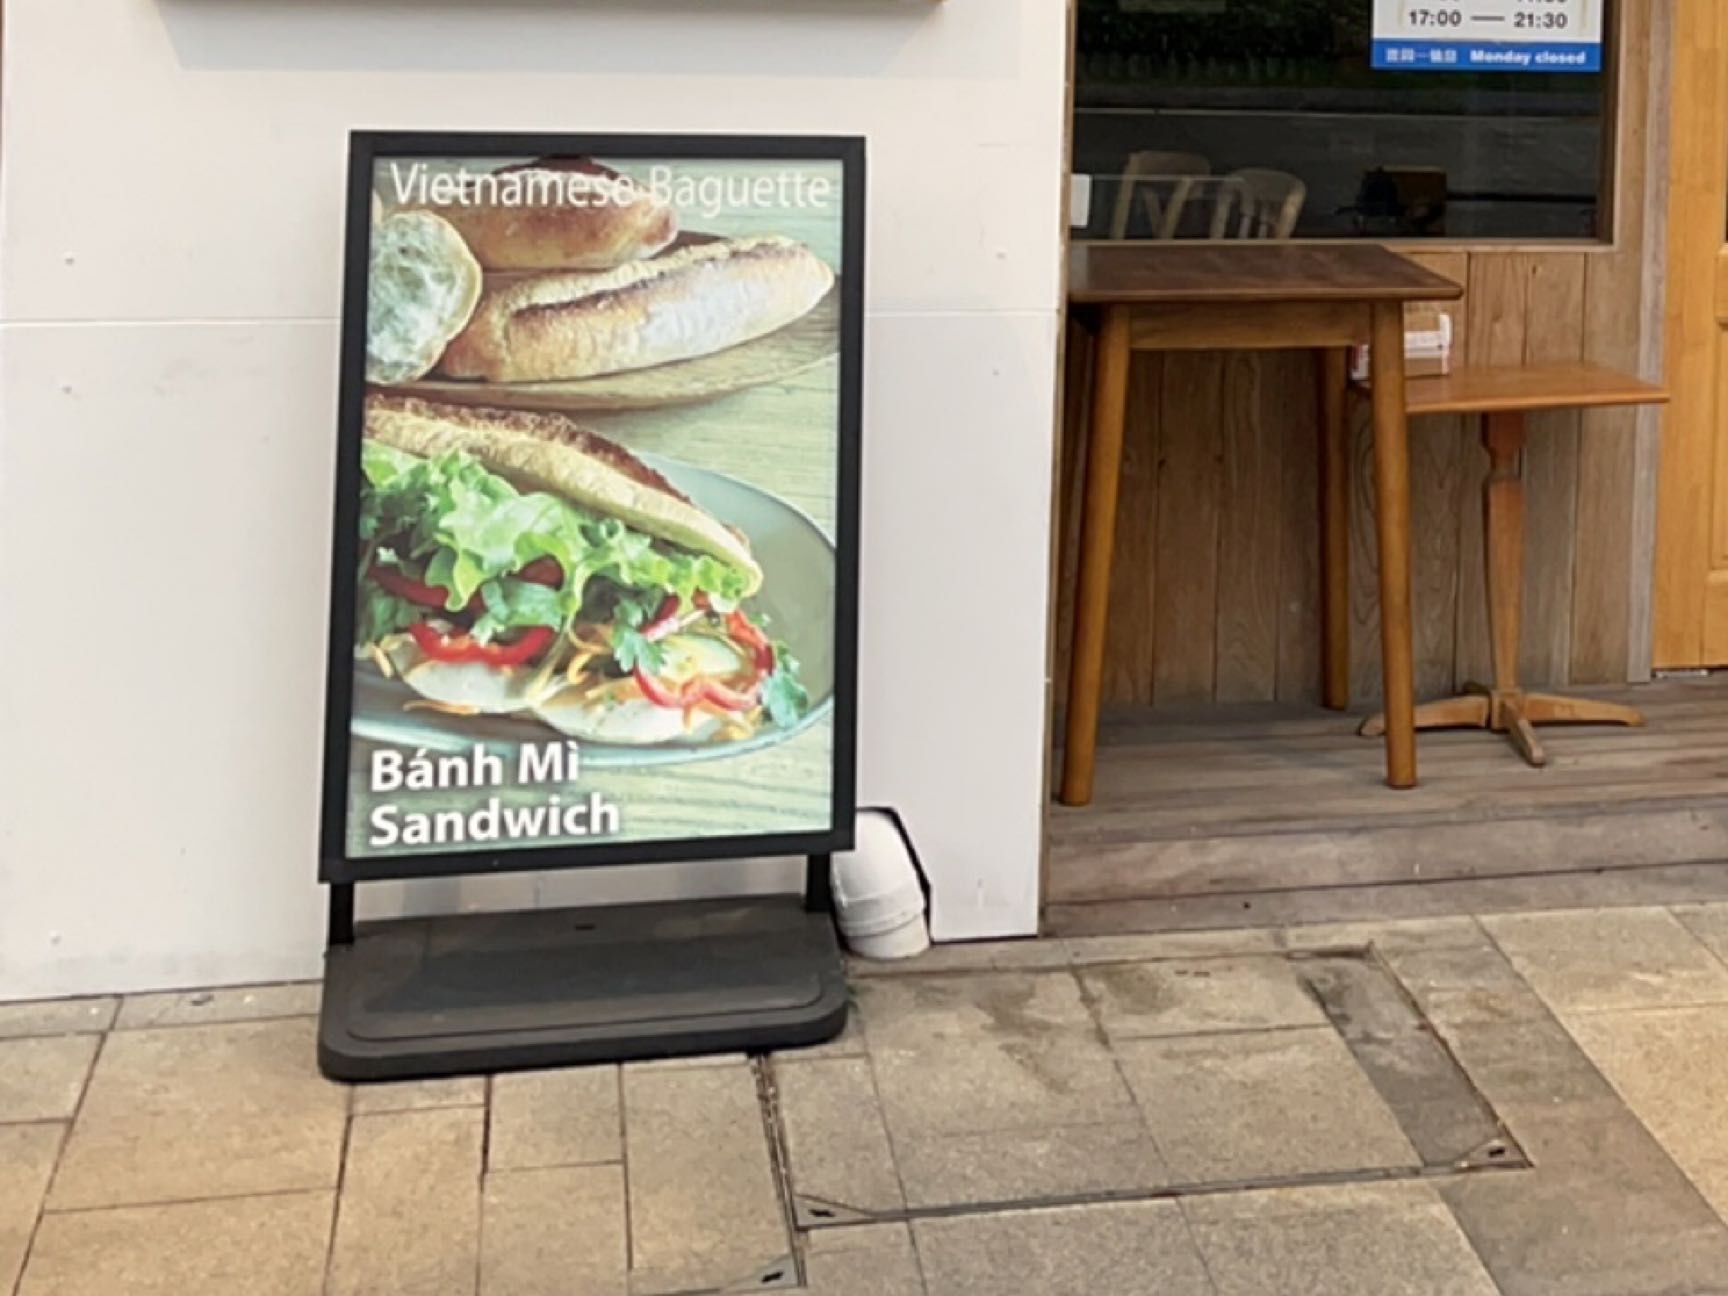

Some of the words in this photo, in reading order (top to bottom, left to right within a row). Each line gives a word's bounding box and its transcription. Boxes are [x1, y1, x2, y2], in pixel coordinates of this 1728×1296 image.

[1408, 9, 1463, 27] 17:00
[1513, 12, 1569, 29] 21:30
[1469, 48, 1533, 66] Monday
[1534, 50, 1587, 65] closed
[389, 162, 640, 207] Vietnamese
[648, 165, 833, 221] Baguette
[370, 742, 503, 793] Bánh
[517, 739, 580, 785] Mì
[368, 791, 621, 847] Sandwich
